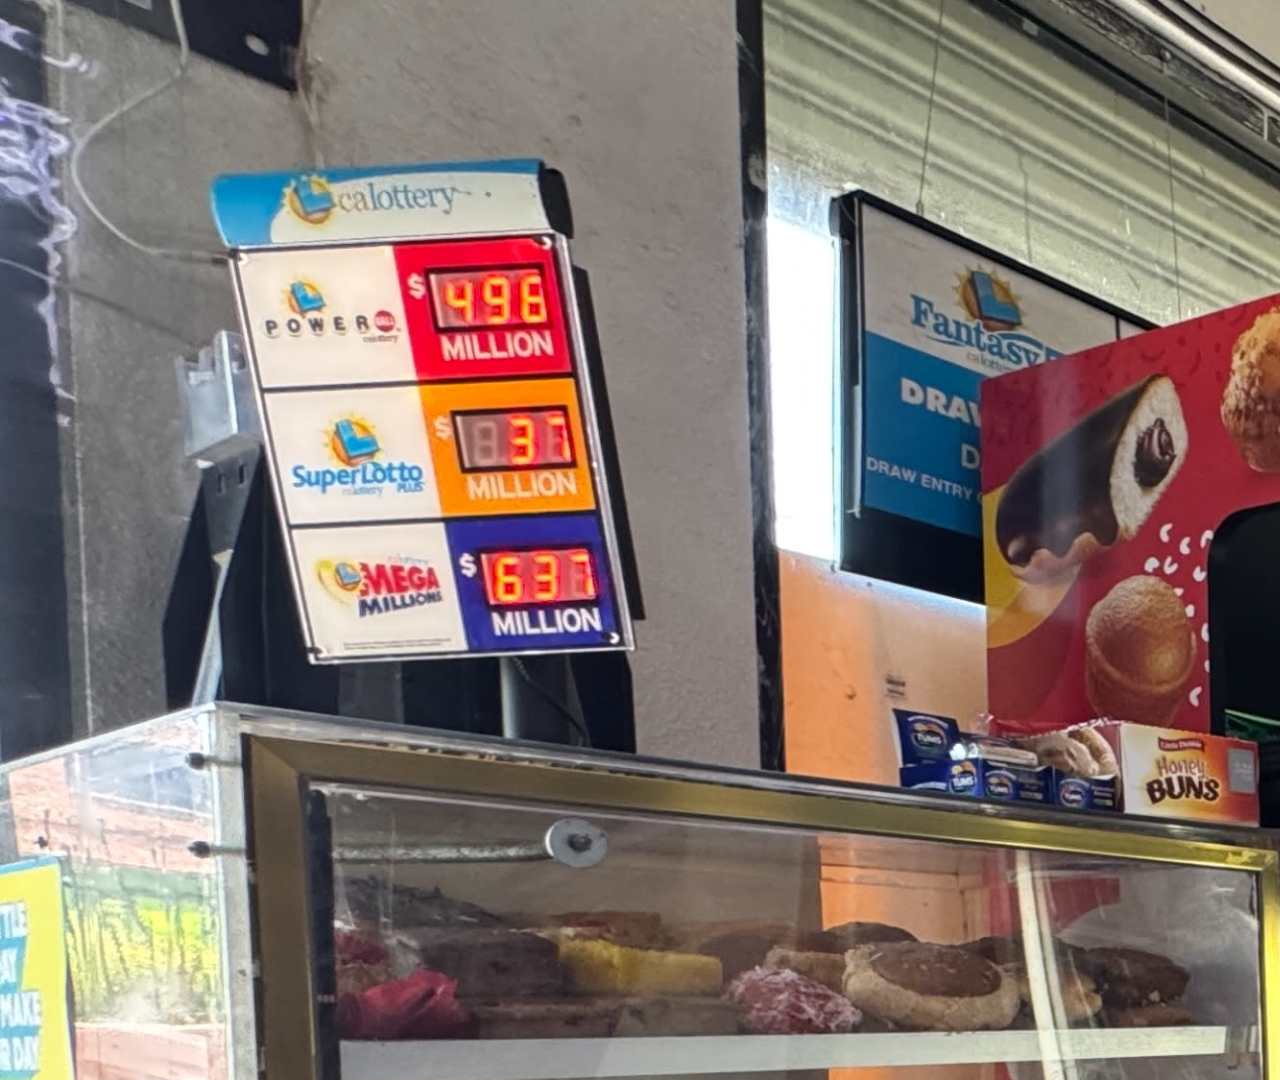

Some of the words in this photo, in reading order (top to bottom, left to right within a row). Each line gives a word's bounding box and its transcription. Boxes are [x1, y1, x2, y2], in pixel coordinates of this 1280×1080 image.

[338, 183, 456, 215] calottery
[407, 273, 426, 299] $
[441, 329, 555, 362] MILLION
[434, 416, 452, 440] $
[293, 461, 424, 494] SuperLotto
[469, 470, 577, 501] MILLION
[866, 455, 918, 484] DRAW
[921, 474, 973, 502] ENTRY
[360, 562, 440, 597] MEGA
[460, 552, 478, 578] $
[494, 548, 595, 601] 637
[359, 590, 443, 617] MILLIONS
[491, 606, 602, 637] MILLION
[1155, 755, 1206, 779] Honey
[1146, 776, 1220, 804] BUNS
